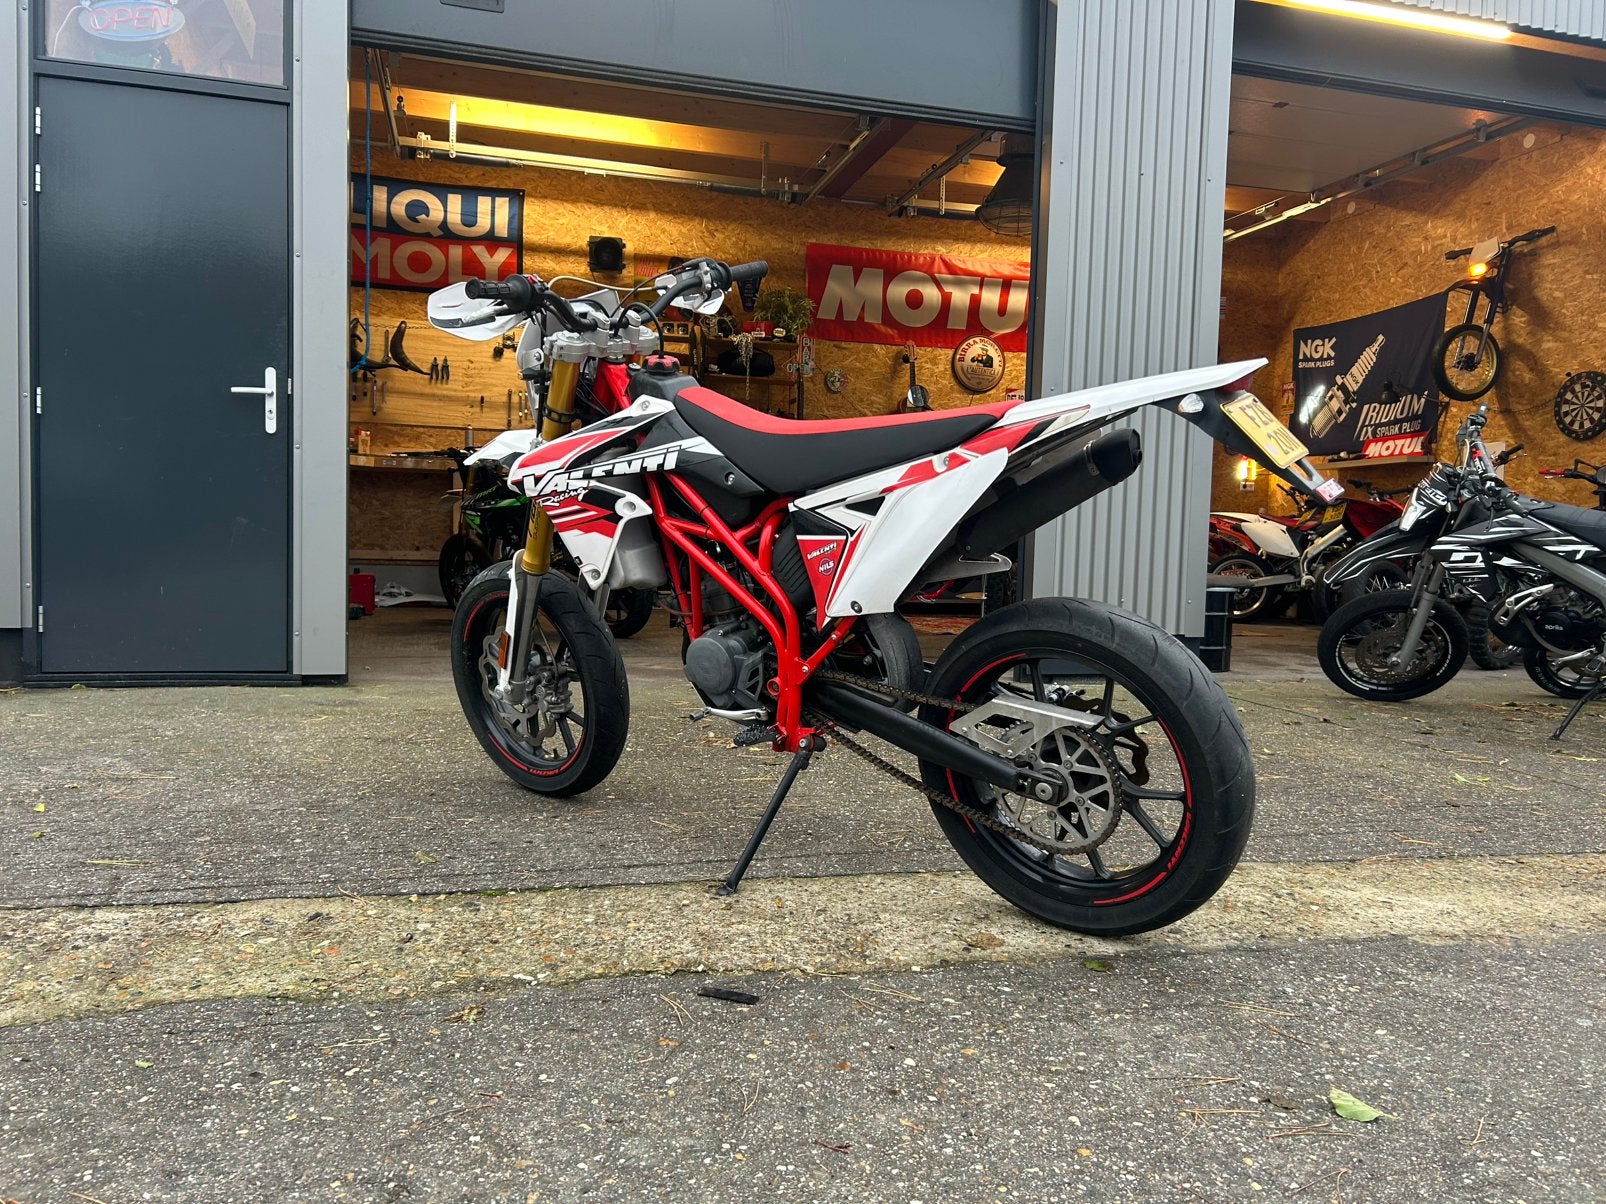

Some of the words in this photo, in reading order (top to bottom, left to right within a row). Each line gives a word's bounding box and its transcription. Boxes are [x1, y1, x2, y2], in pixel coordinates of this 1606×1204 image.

[88, 7, 172, 32] OPEN
[351, 232, 514, 284] MOLY
[816, 264, 1030, 334] MOTU
[957, 339, 979, 363] BIRRA
[1298, 336, 1337, 360] NGK
[1298, 360, 1316, 369] SPARK
[1315, 359, 1336, 369] PLUGS
[1348, 372, 1361, 387] NGK
[1353, 390, 1429, 441] IRIDIUM
[1359, 425, 1375, 441] IX
[1375, 423, 1400, 438] SPARK
[1401, 419, 1422, 434] PLUG
[1364, 436, 1425, 458] MOTUL
[523, 449, 679, 497] VALENTI
[538, 487, 589, 508] Racing
[806, 540, 838, 561] VALENTI
[818, 560, 835, 573] NILS
